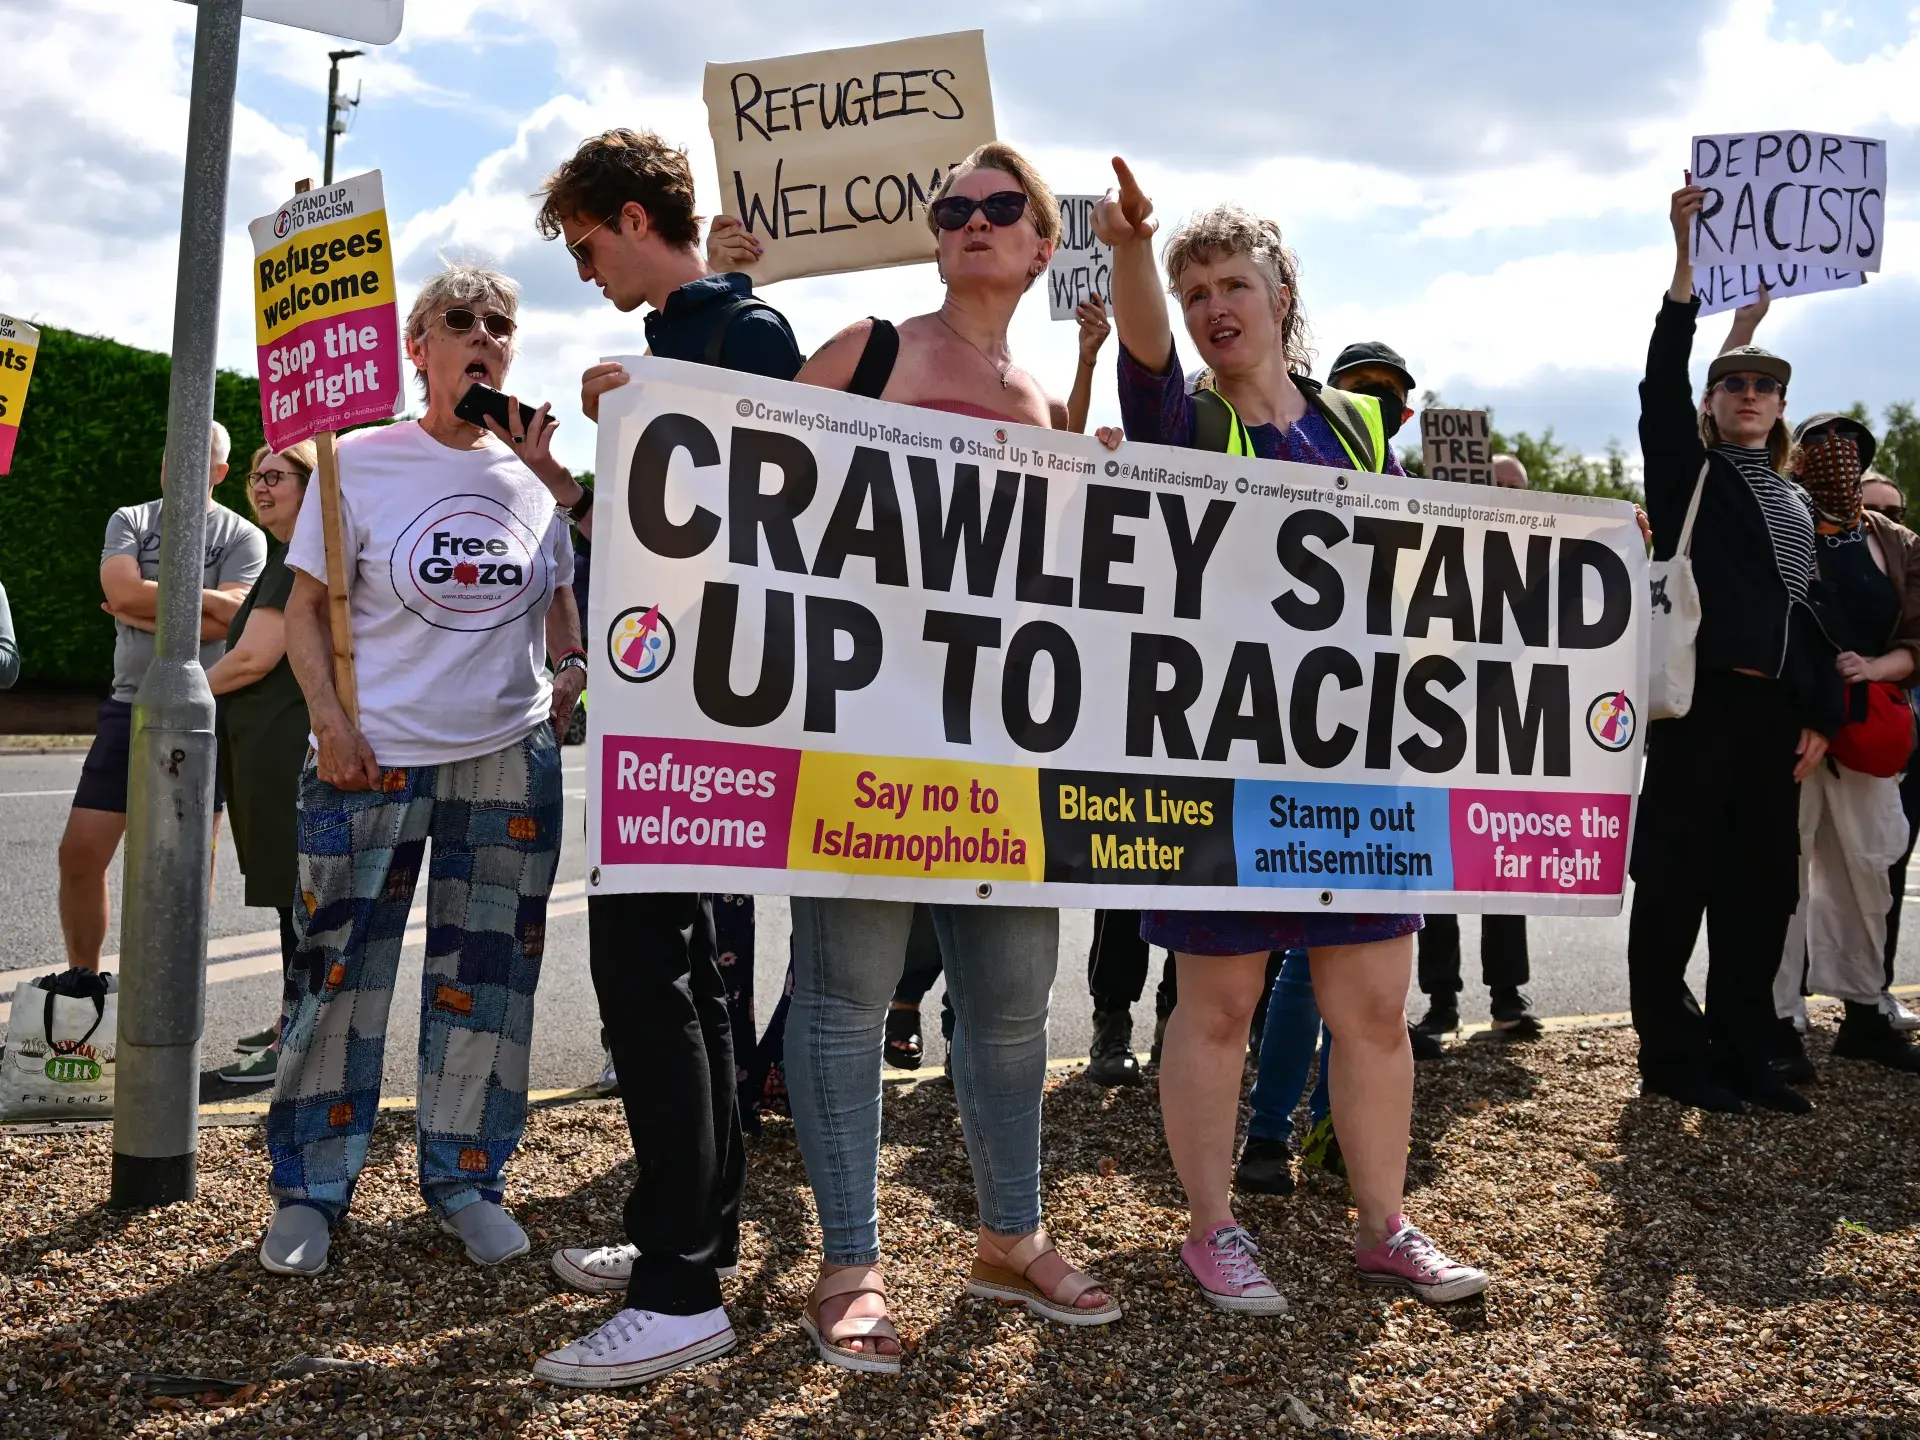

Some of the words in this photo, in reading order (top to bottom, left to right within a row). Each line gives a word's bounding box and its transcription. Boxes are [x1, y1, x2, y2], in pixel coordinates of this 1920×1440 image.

[731, 69, 964, 141] REFUGEES
[1696, 134, 1878, 179] DEPORT
[291, 194, 326, 216] STAND
[330, 188, 346, 203] UP
[292, 215, 304, 230] TO
[307, 201, 353, 224] RACISM
[733, 158, 962, 240] WELCOM
[1695, 182, 1880, 258] RACISTS
[260, 229, 383, 293] Refugees
[1, 318, 13, 328] UP
[263, 271, 379, 329] welcome
[0, 348, 28, 371] ts
[267, 340, 316, 383] Stop
[324, 323, 378, 358] the
[270, 388, 301, 423] far
[305, 360, 379, 408] right
[1424, 412, 1473, 437] HOW
[755, 402, 943, 450] CrawleyStandUpToRacism
[968, 440, 1004, 461] Stand
[1010, 446, 1027, 467] Up
[1032, 450, 1043, 467] To
[1048, 453, 1096, 475] Racism
[1120, 463, 1228, 494] @AntiRacismDay
[1251, 484, 1399, 512] crawleysutr@gmail.com
[1422, 503, 1556, 529] standuptoracism.org.uk
[432, 532, 509, 556] Free
[627, 412, 1236, 620] CRAWLEY
[1270, 508, 1632, 649] STAND
[693, 581, 883, 734] UP
[922, 609, 1082, 754] TO
[1125, 632, 1571, 777] RACISM
[617, 750, 776, 803] Refugees
[854, 770, 912, 819] Say
[922, 783, 958, 812] no
[970, 778, 999, 814] to
[617, 805, 766, 849] welcome
[1059, 784, 1136, 822] Black
[1145, 788, 1214, 826] Lives
[1268, 794, 1360, 841] Stamp
[1370, 801, 1415, 832] out
[1466, 801, 1572, 842] Oppose
[1581, 806, 1620, 839] the
[811, 818, 1027, 871] Islamophobia
[1091, 833, 1184, 871] Matter
[1255, 841, 1433, 877] antisemitism
[1494, 846, 1532, 879] far
[1540, 847, 1602, 888] right
[54, 1060, 93, 1080] PERK
